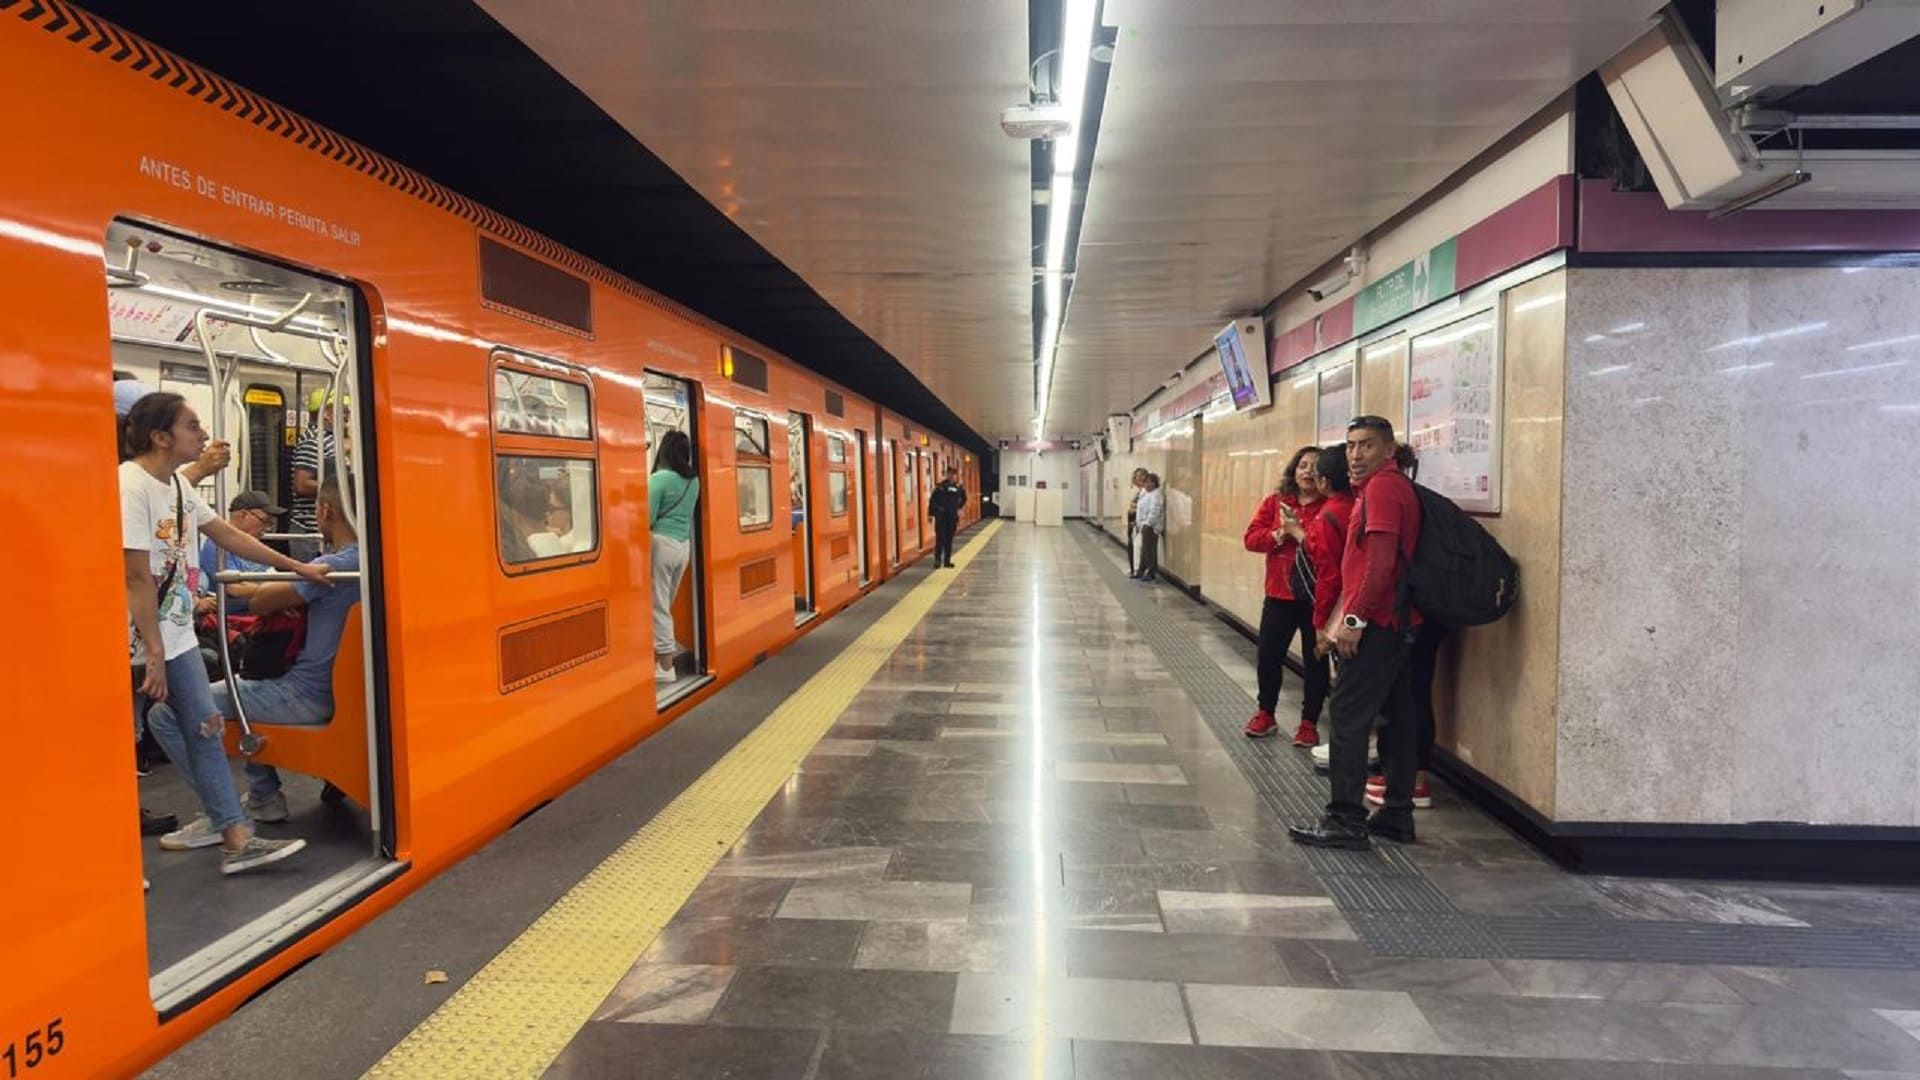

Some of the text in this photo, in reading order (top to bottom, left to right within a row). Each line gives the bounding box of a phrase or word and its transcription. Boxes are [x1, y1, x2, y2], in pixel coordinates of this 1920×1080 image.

[140, 155, 360, 248] ANTES DE ENTRAR PERMITA SALIR
[2, 1017, 64, 1078] 155
